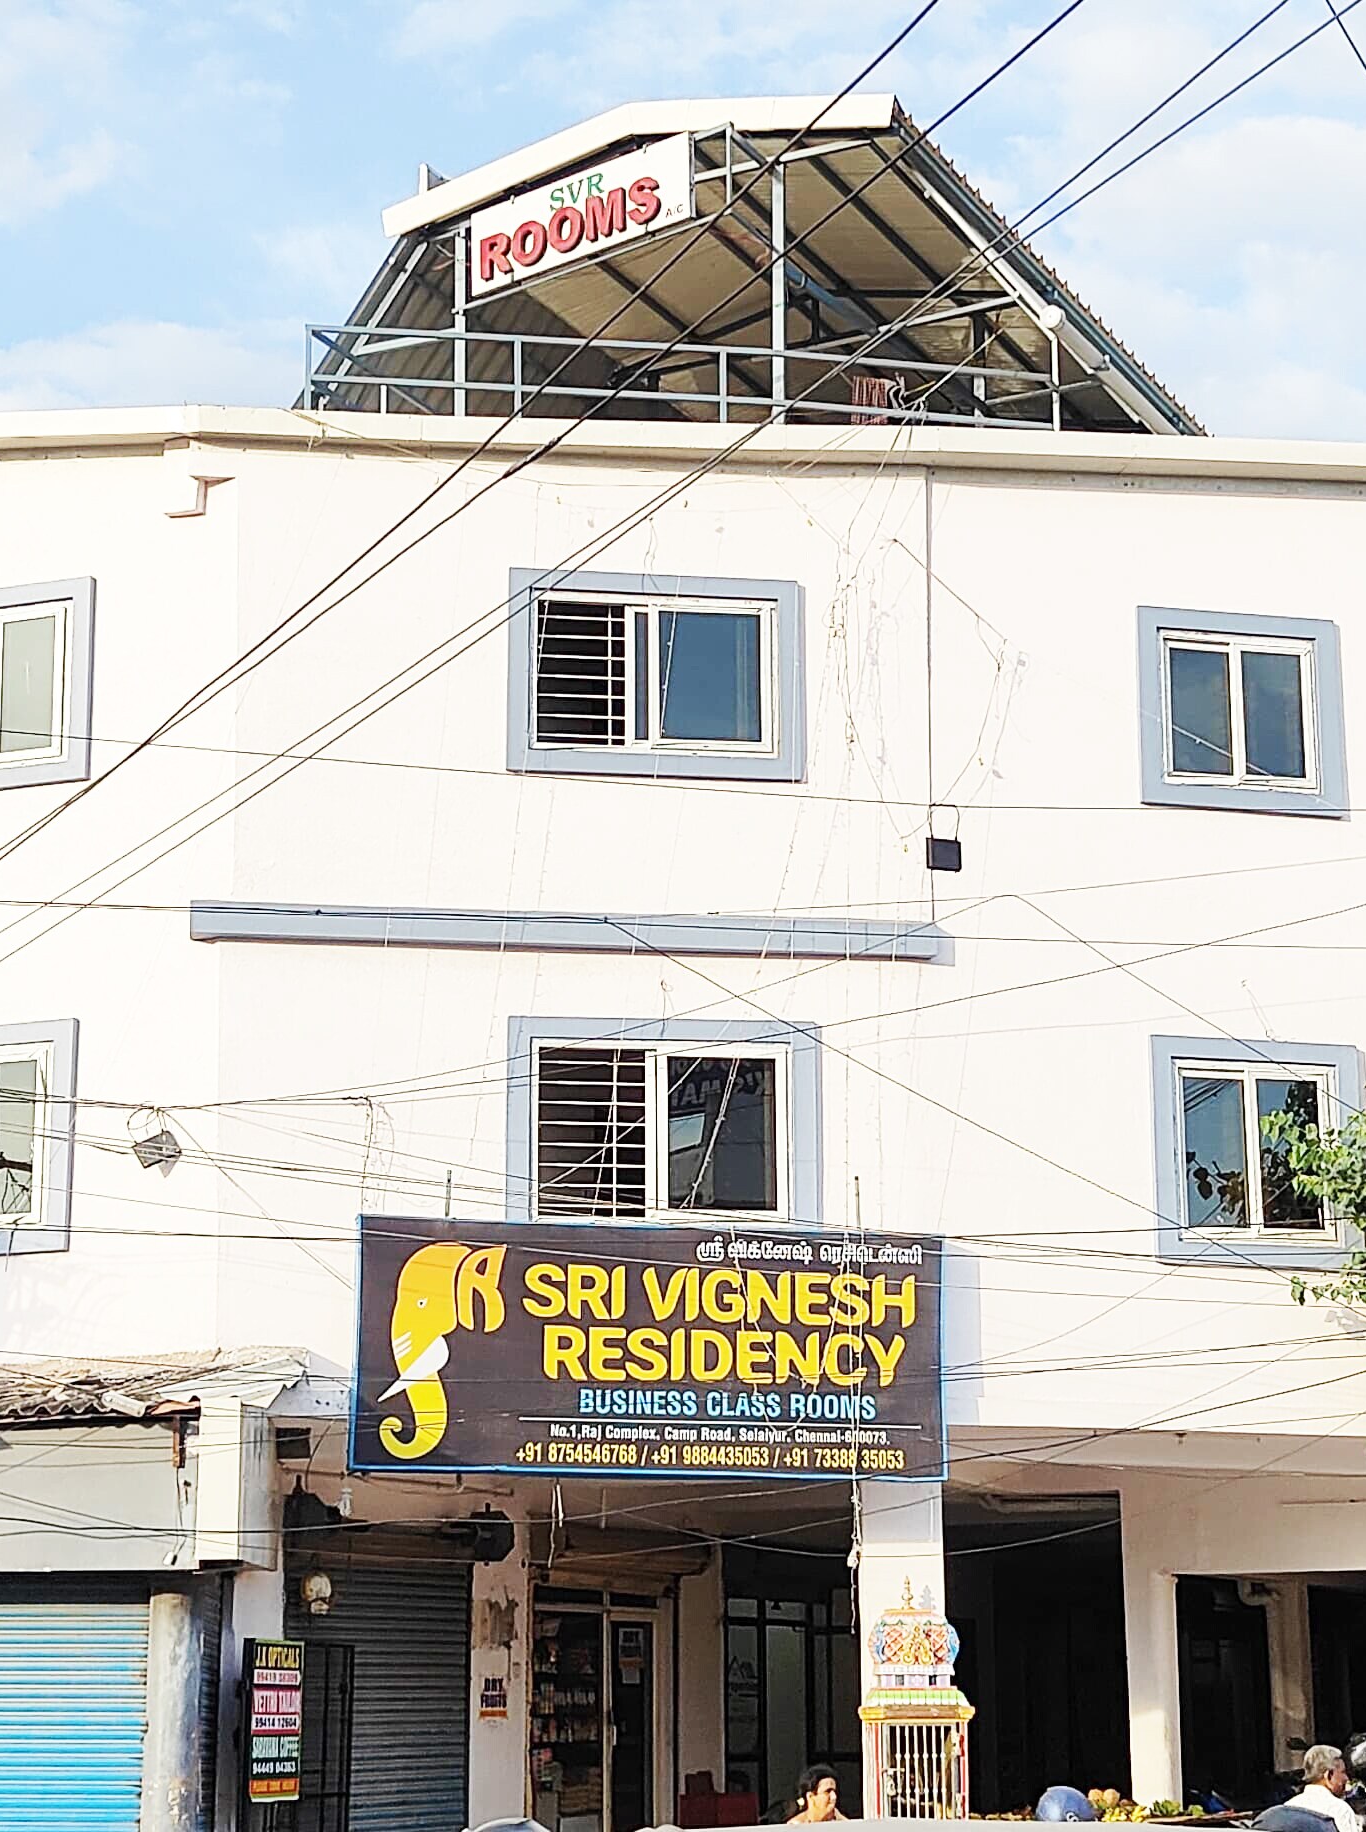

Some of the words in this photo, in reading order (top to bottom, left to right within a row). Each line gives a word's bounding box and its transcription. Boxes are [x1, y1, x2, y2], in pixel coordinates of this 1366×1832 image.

[549, 173, 605, 211] SVR
[479, 176, 662, 281] ROOMS
[523, 1263, 626, 1320] SRI
[642, 1266, 916, 1328] VIGNESH
[544, 1324, 906, 1387] RESIDENCY
[579, 1388, 697, 1416] BUSINESS
[706, 1391, 781, 1418] CLASS
[790, 1394, 877, 1420] ROOMS
[664, 1427, 697, 1442] Camp
[701, 1428, 735, 1443] Road,
[515, 1442, 542, 1463] +91
[548, 1443, 637, 1464] 8754546768
[651, 1445, 677, 1465] +91
[683, 1445, 769, 1466] 9884435053
[783, 1447, 810, 1467] +91
[814, 1448, 856, 1468] 73388
[861, 1450, 905, 1470] 35053
[268, 1646, 300, 1669] OPTICALS
